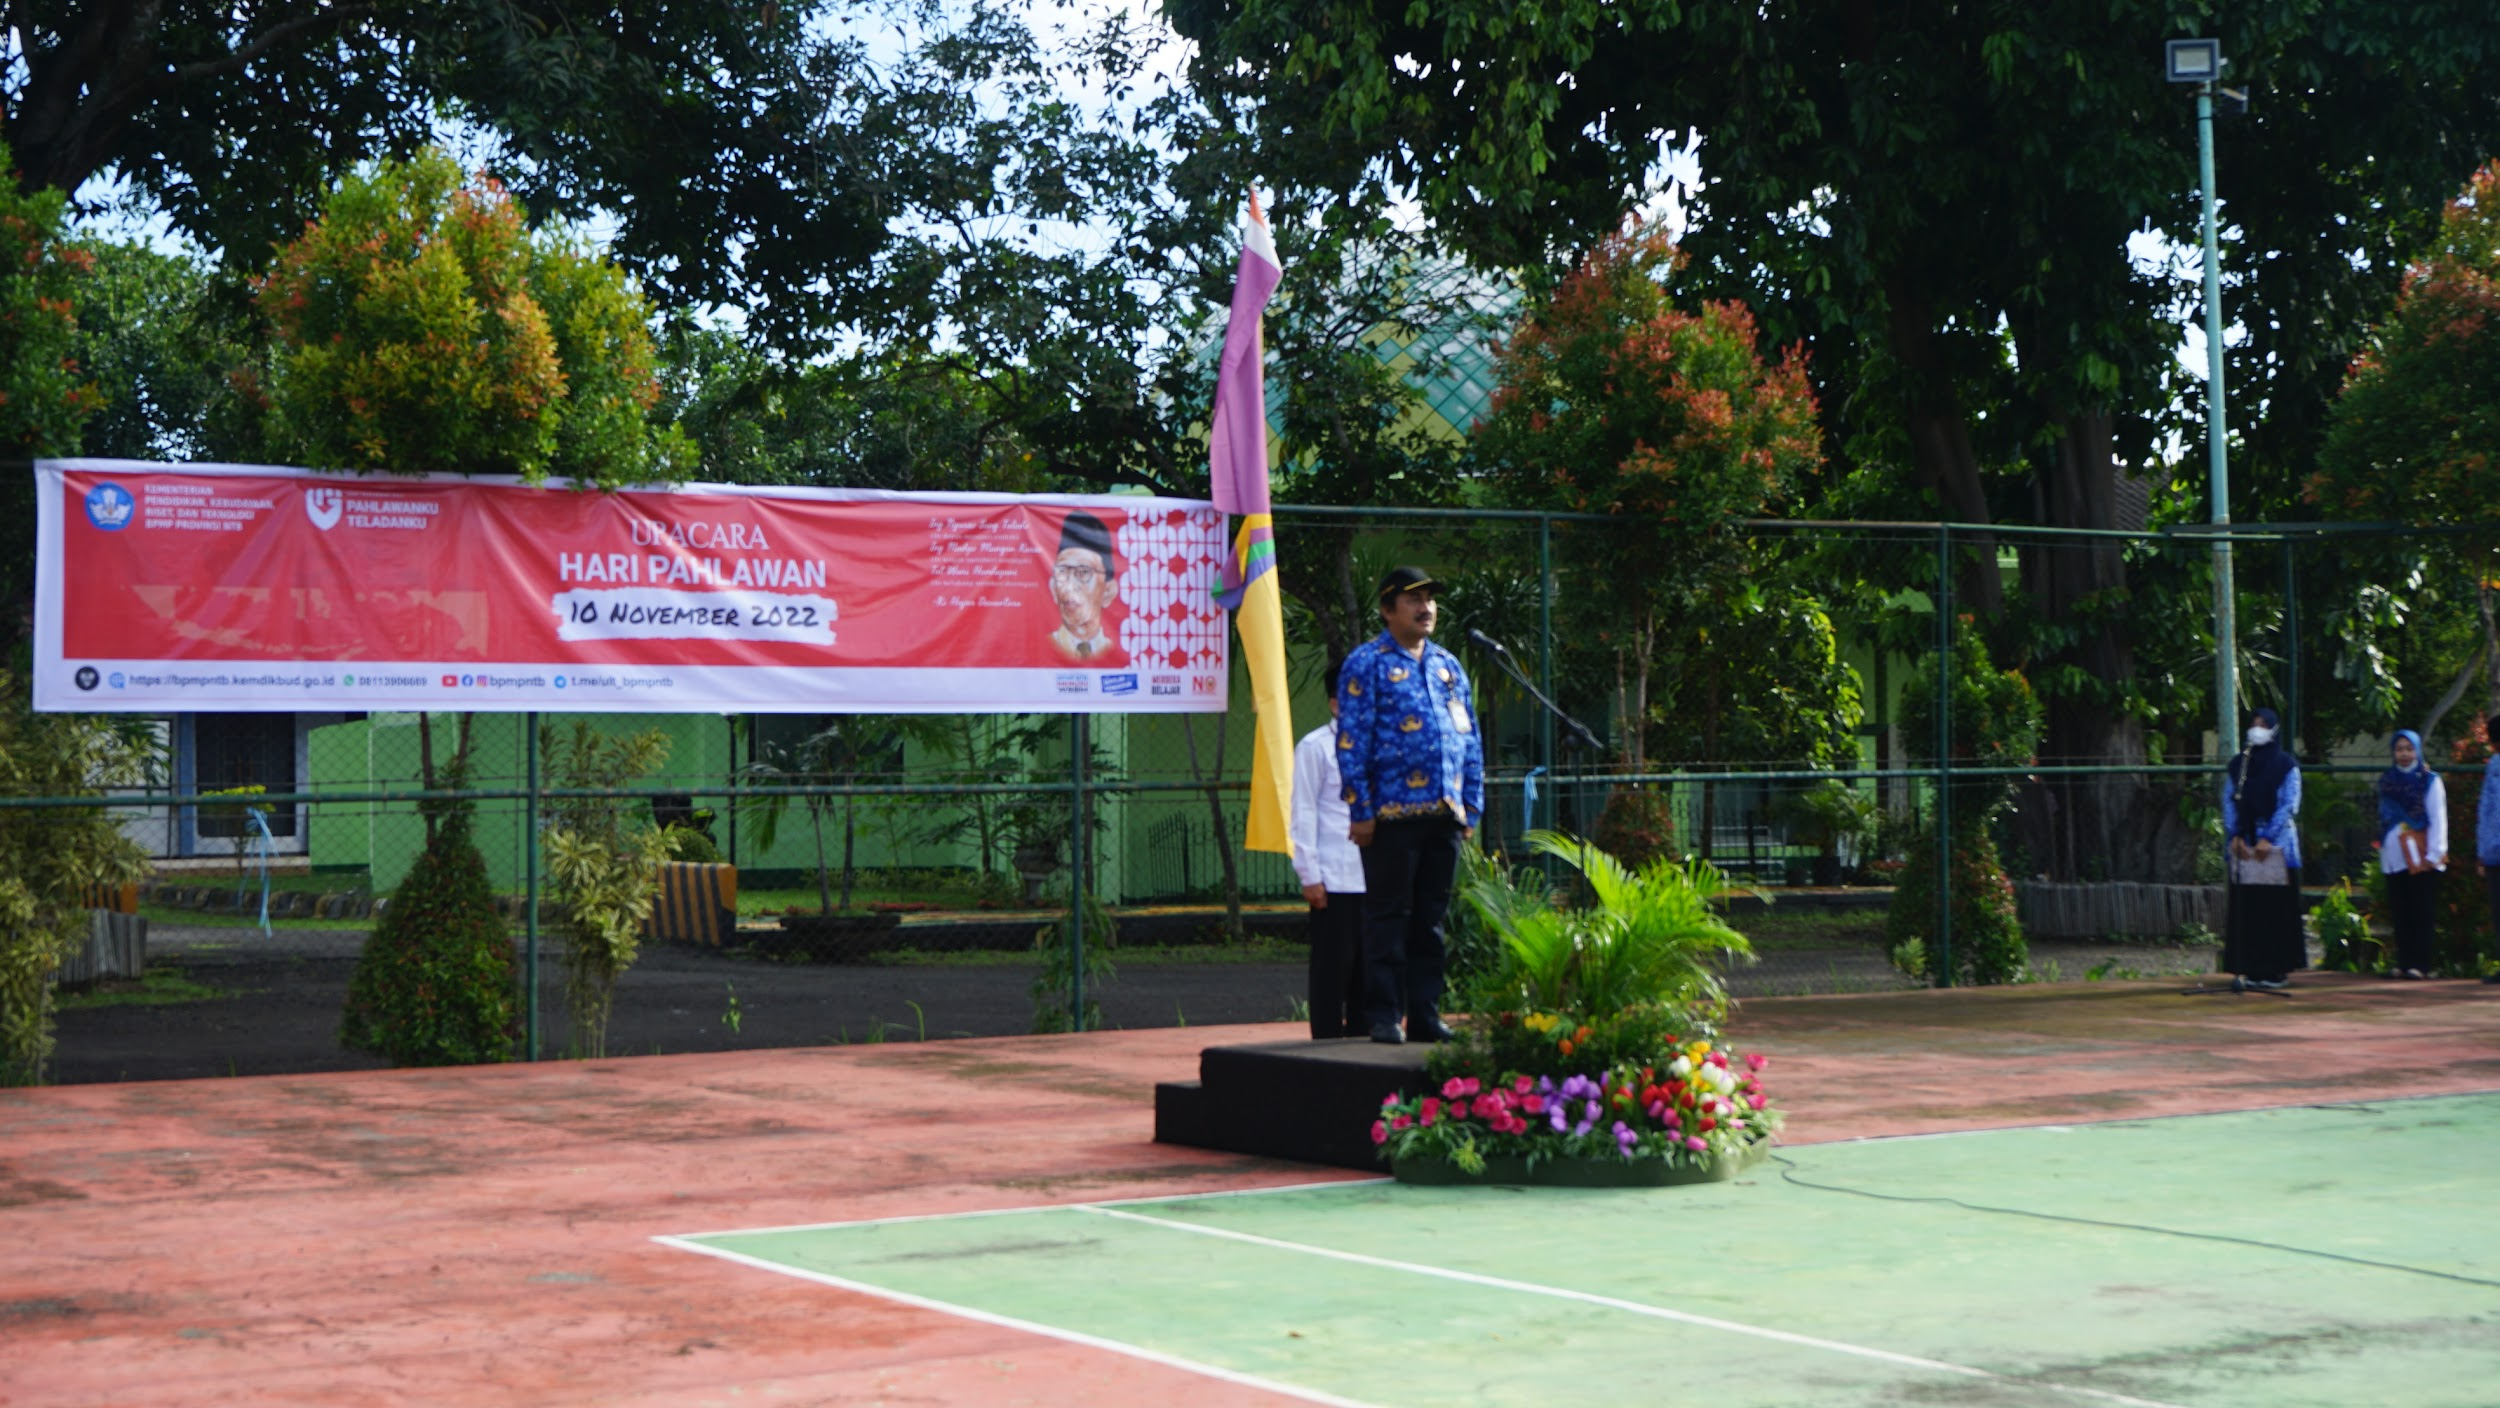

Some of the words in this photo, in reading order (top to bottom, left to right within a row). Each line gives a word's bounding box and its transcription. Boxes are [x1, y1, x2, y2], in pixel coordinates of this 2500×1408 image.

[144, 484, 214, 496] KEMENTERIAN
[176, 509, 199, 518] DAN
[346, 500, 439, 515] PAHLAWANKU
[346, 515, 427, 529] TELADANKU
[631, 519, 770, 550] UPACARA
[560, 552, 639, 583] HARI
[647, 554, 826, 588] PAHLAWAN
[570, 601, 598, 624] 10
[609, 603, 740, 627] NOVEMBER
[751, 606, 819, 628] 2022
[490, 675, 546, 689] bpmpntb
[1151, 685, 1181, 696] BELAJAR
